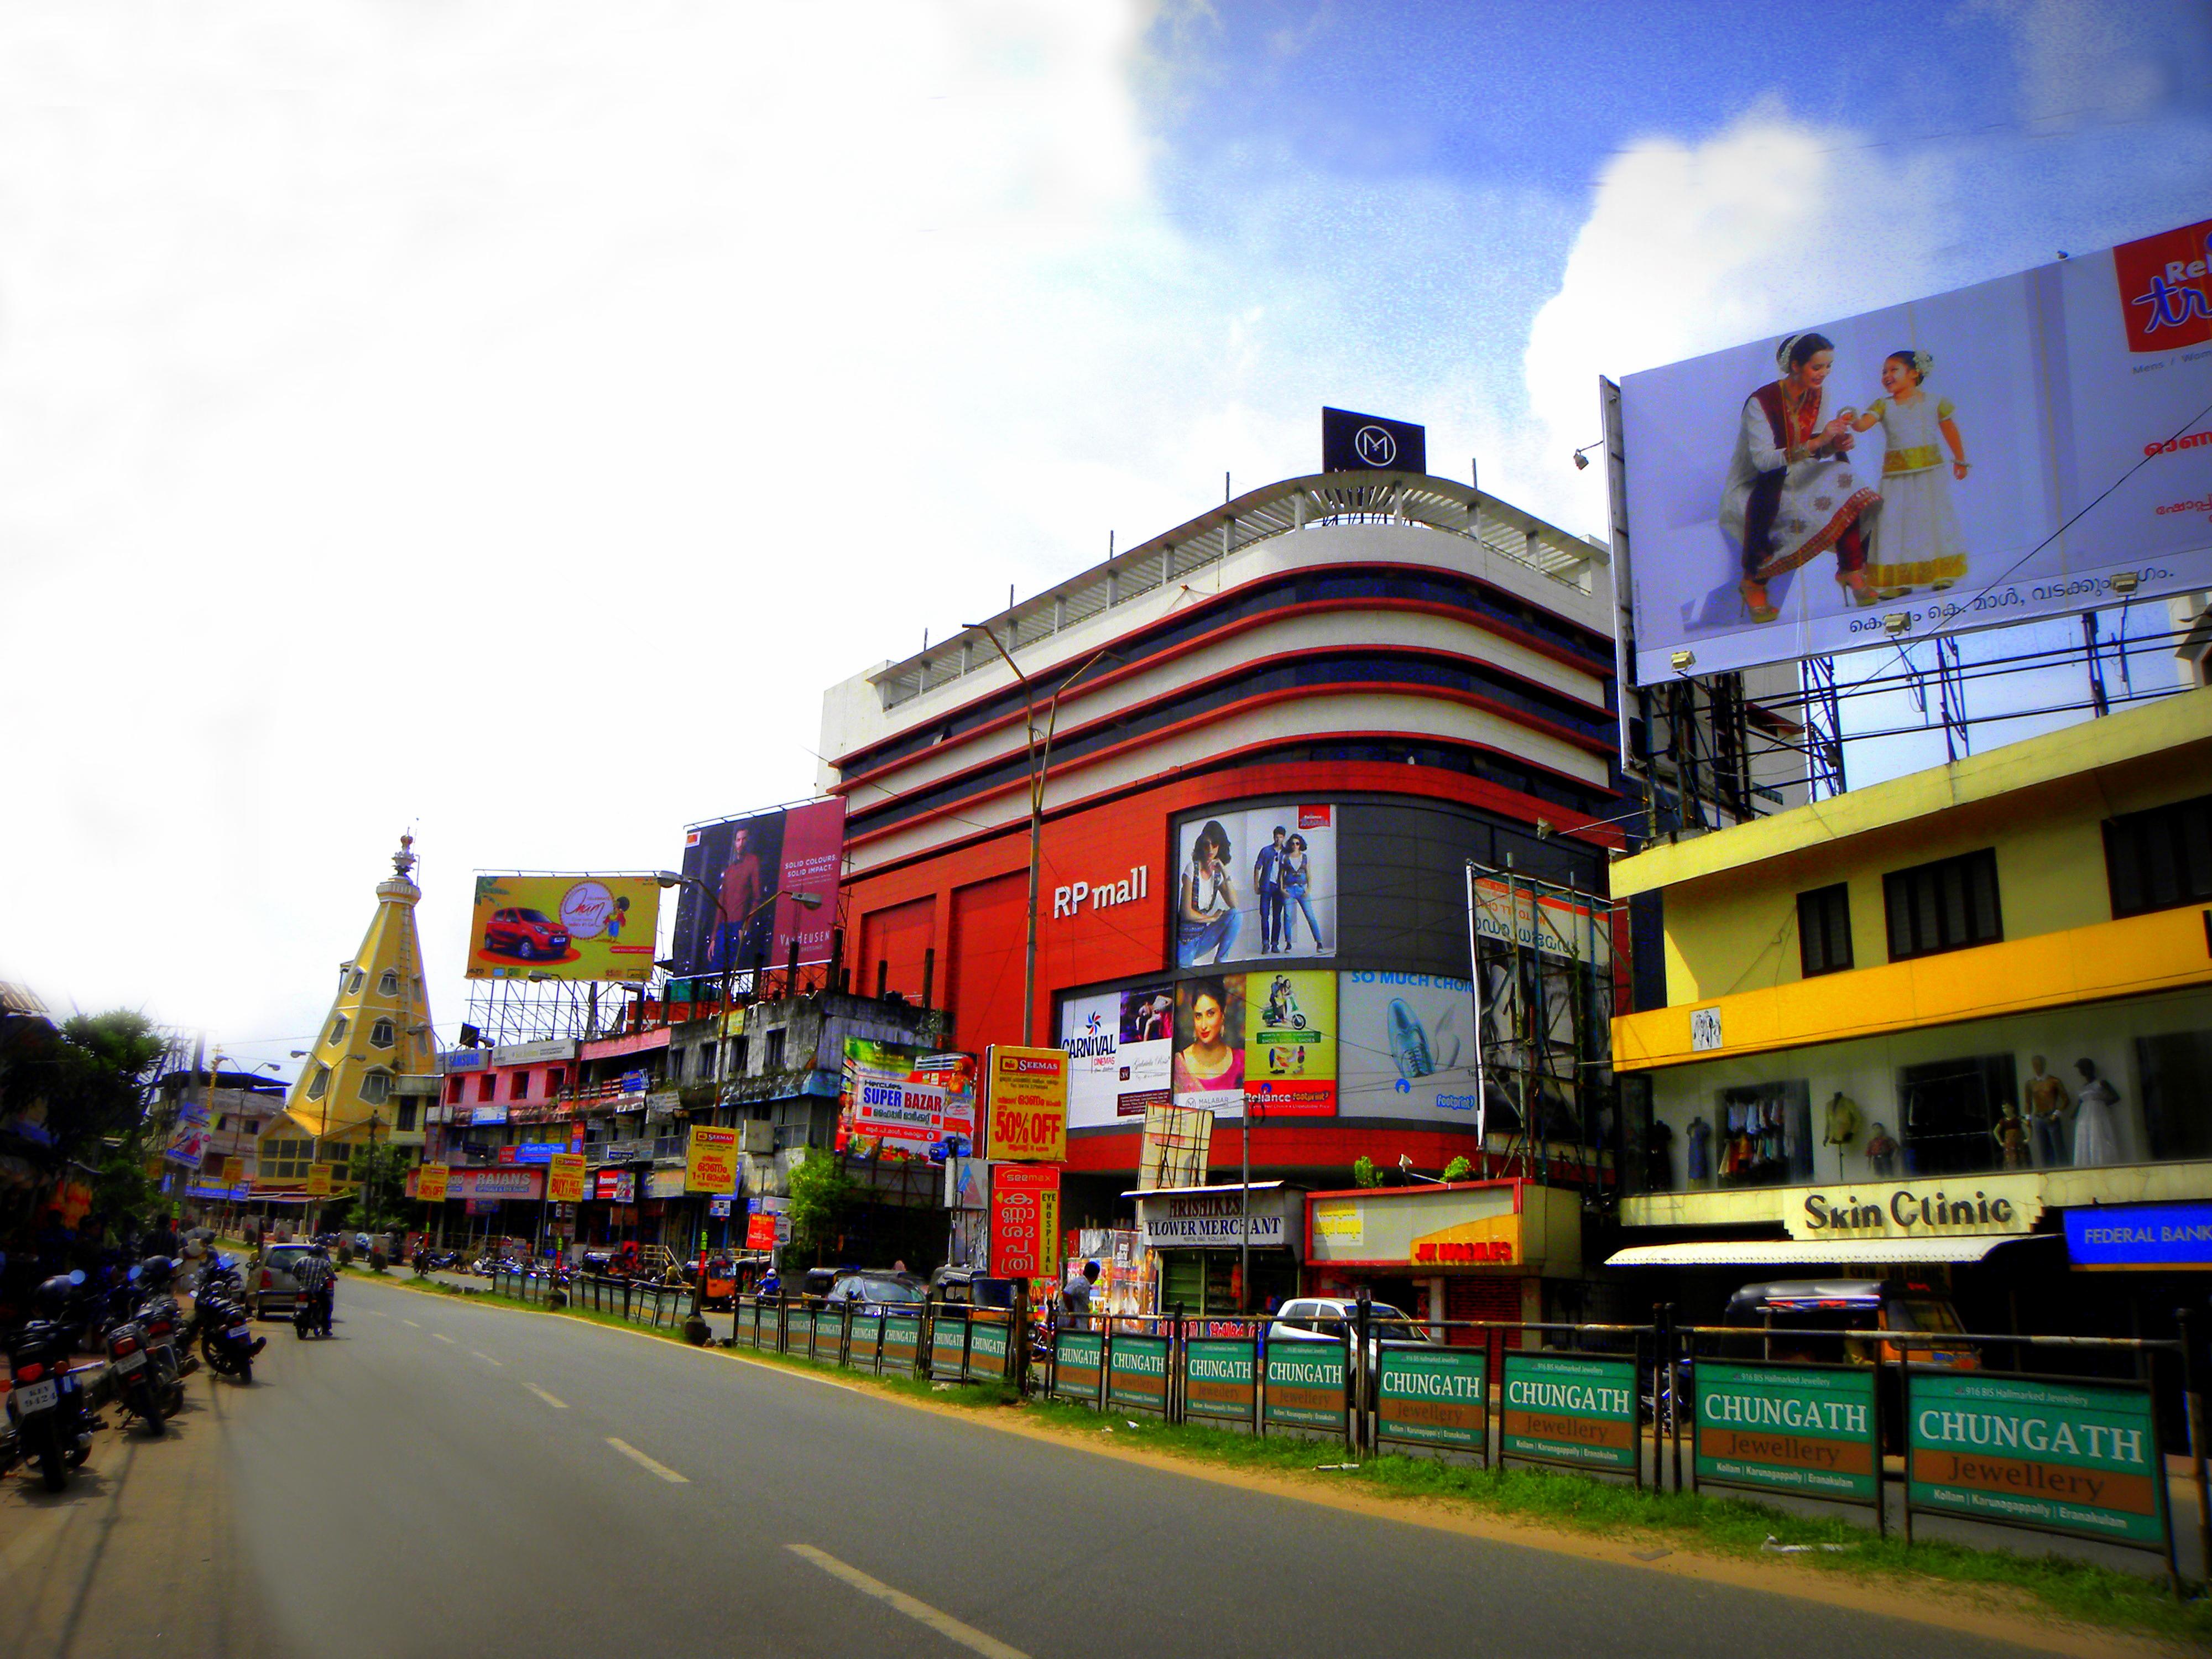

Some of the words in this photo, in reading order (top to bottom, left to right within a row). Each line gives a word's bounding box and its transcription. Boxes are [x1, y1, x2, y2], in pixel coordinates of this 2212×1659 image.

[2132, 361, 2164, 374] Mens
[785, 860, 804, 869] SOLID
[805, 854, 838, 865] COLOURS.
[787, 869, 806, 878] SOLID
[808, 864, 833, 874] IMPACT.
[1054, 881, 1088, 919] RP
[1092, 865, 1147, 910] mall
[797, 930, 830, 945] HEUSEN
[1352, 971, 1375, 983] SO
[1380, 972, 1430, 987] MUCH
[1062, 1034, 1117, 1058] CARNIVAL
[449, 1053, 479, 1067] SAMSUNG
[1019, 1060, 1058, 1072] SEEMAS
[1094, 1057, 1115, 1066] CINEMAS
[864, 1079, 902, 1091] Hercules
[864, 1087, 902, 1107] SUPER
[904, 1092, 942, 1112] BAZAR
[1245, 1092, 1291, 1103] Reliance
[995, 1111, 1029, 1144] 50%
[1031, 1113, 1061, 1145] OFF
[477, 1172, 531, 1185] RAJANS
[1006, 1173, 1051, 1182] seemax
[1042, 1193, 1056, 1202] EYE
[1804, 1194, 1882, 1229] Skin
[1890, 1190, 2012, 1227] Clinic
[1148, 1219, 1196, 1236] FLOWER
[2085, 1226, 2156, 1244] FEDERAL
[885, 1329, 918, 1343] CHUNGATH
[933, 1331, 964, 1347] CHUNGATH
[972, 1336, 1006, 1355] CHUNGATH
[1057, 1347, 1100, 1366] CHUNGATH
[1113, 1352, 1165, 1373] CHUNGATH
[1190, 1359, 1251, 1379] CHUNGATH
[1269, 1361, 1343, 1384] CHUNGATH
[1383, 1371, 1480, 1397] CHUNGATH
[1509, 1381, 1630, 1413] CHUNGATH
[1965, 1387, 1980, 1397] 916
[1981, 1388, 1994, 1397] BIS
[1996, 1389, 2046, 1402] Hallmarked
[2046, 1392, 2089, 1408] Jewellery
[1705, 1393, 1867, 1433] CHUNGATH
[1525, 1415, 1608, 1442] Jewellery
[1918, 1410, 2145, 1464] CHUNGATH
[1728, 1433, 1840, 1466] Jewellery
[1717, 1462, 1741, 1474] Kollam
[1948, 1455, 2105, 1503] Jewellery
[1933, 1489, 1965, 1504] Kollam
[1971, 1494, 2051, 1519] Karunagappally
[2059, 1506, 2128, 1529] Eranakulam
